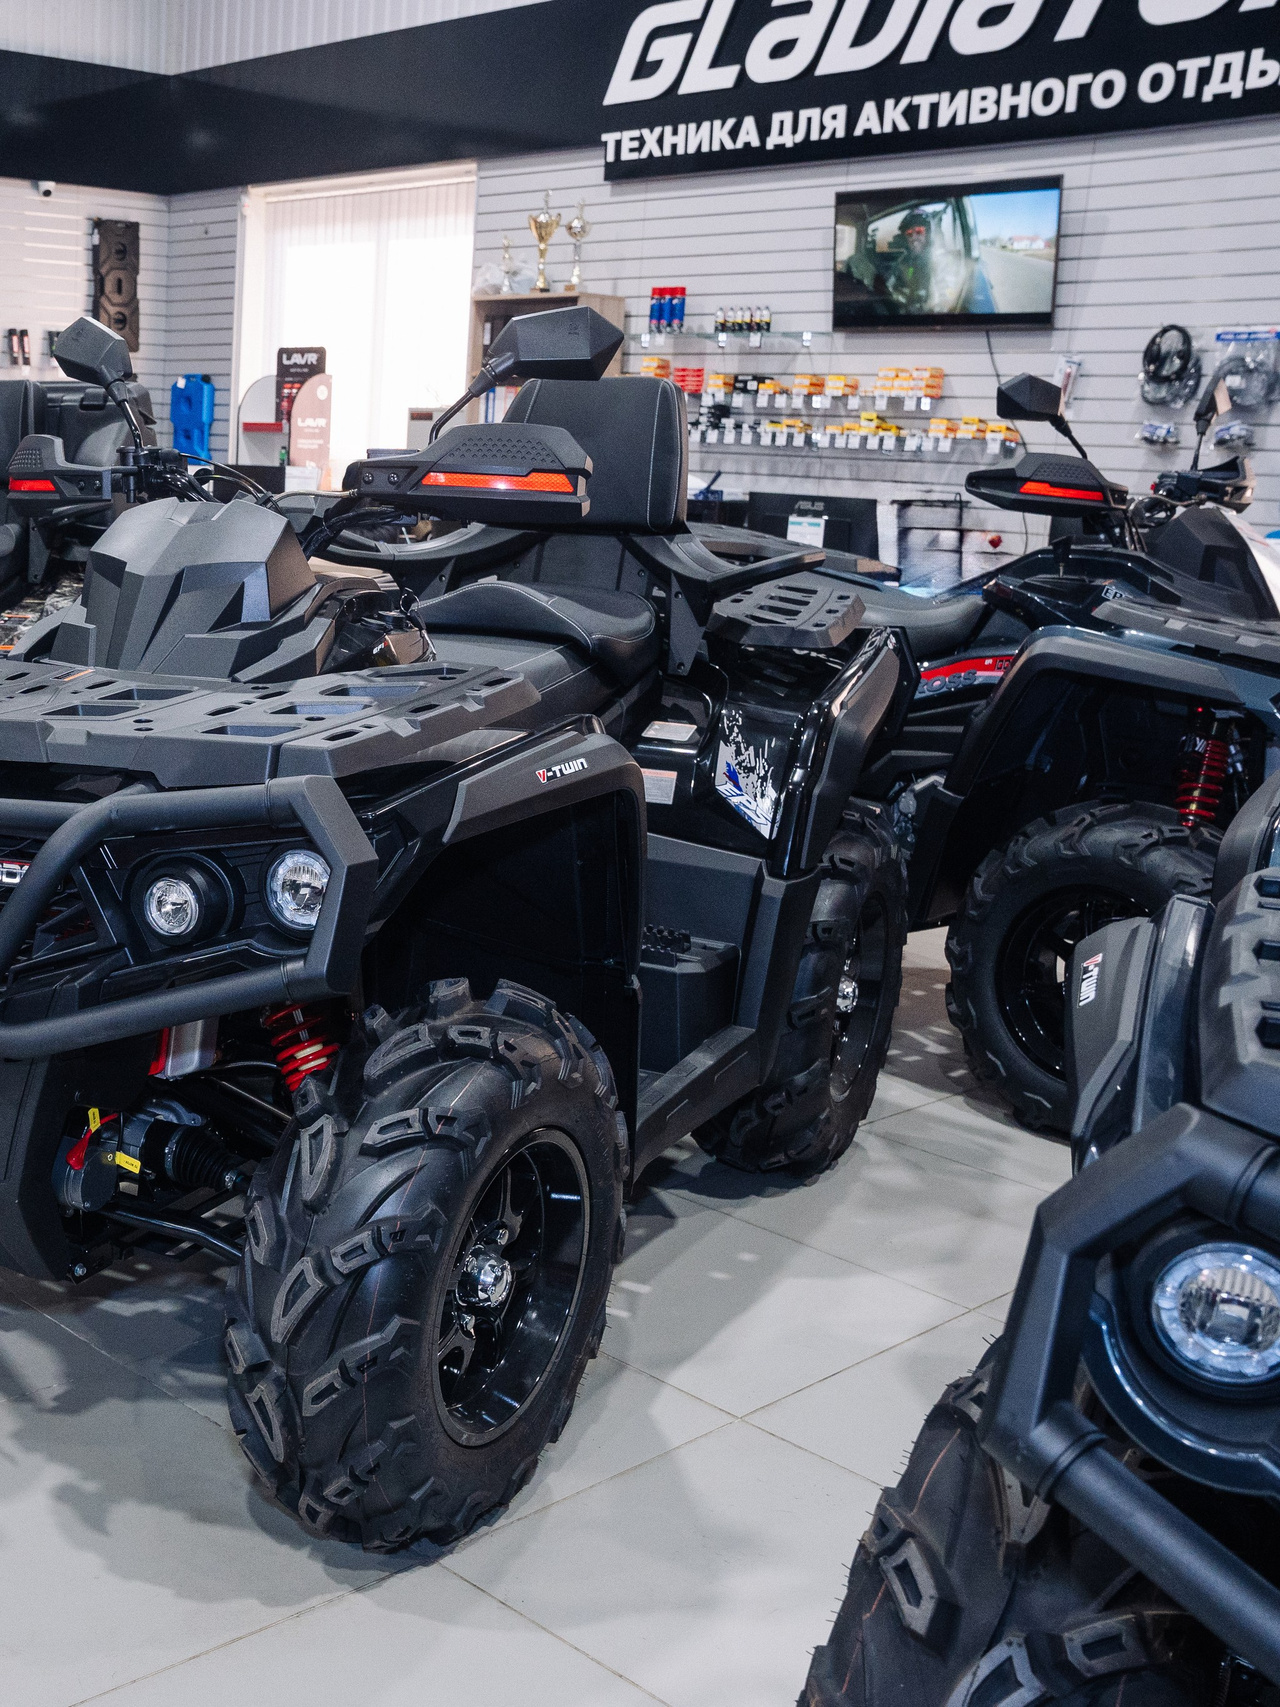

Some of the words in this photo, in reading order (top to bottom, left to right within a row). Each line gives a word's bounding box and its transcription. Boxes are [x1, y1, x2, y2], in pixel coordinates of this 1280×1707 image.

[601, 114, 761, 163] ТЕХНИКА
[766, 104, 847, 150] ДЛЯ
[853, 68, 1127, 136] АКТИВНОГО
[282, 352, 319, 366] LAVR
[1103, 587, 1124, 600] EP
